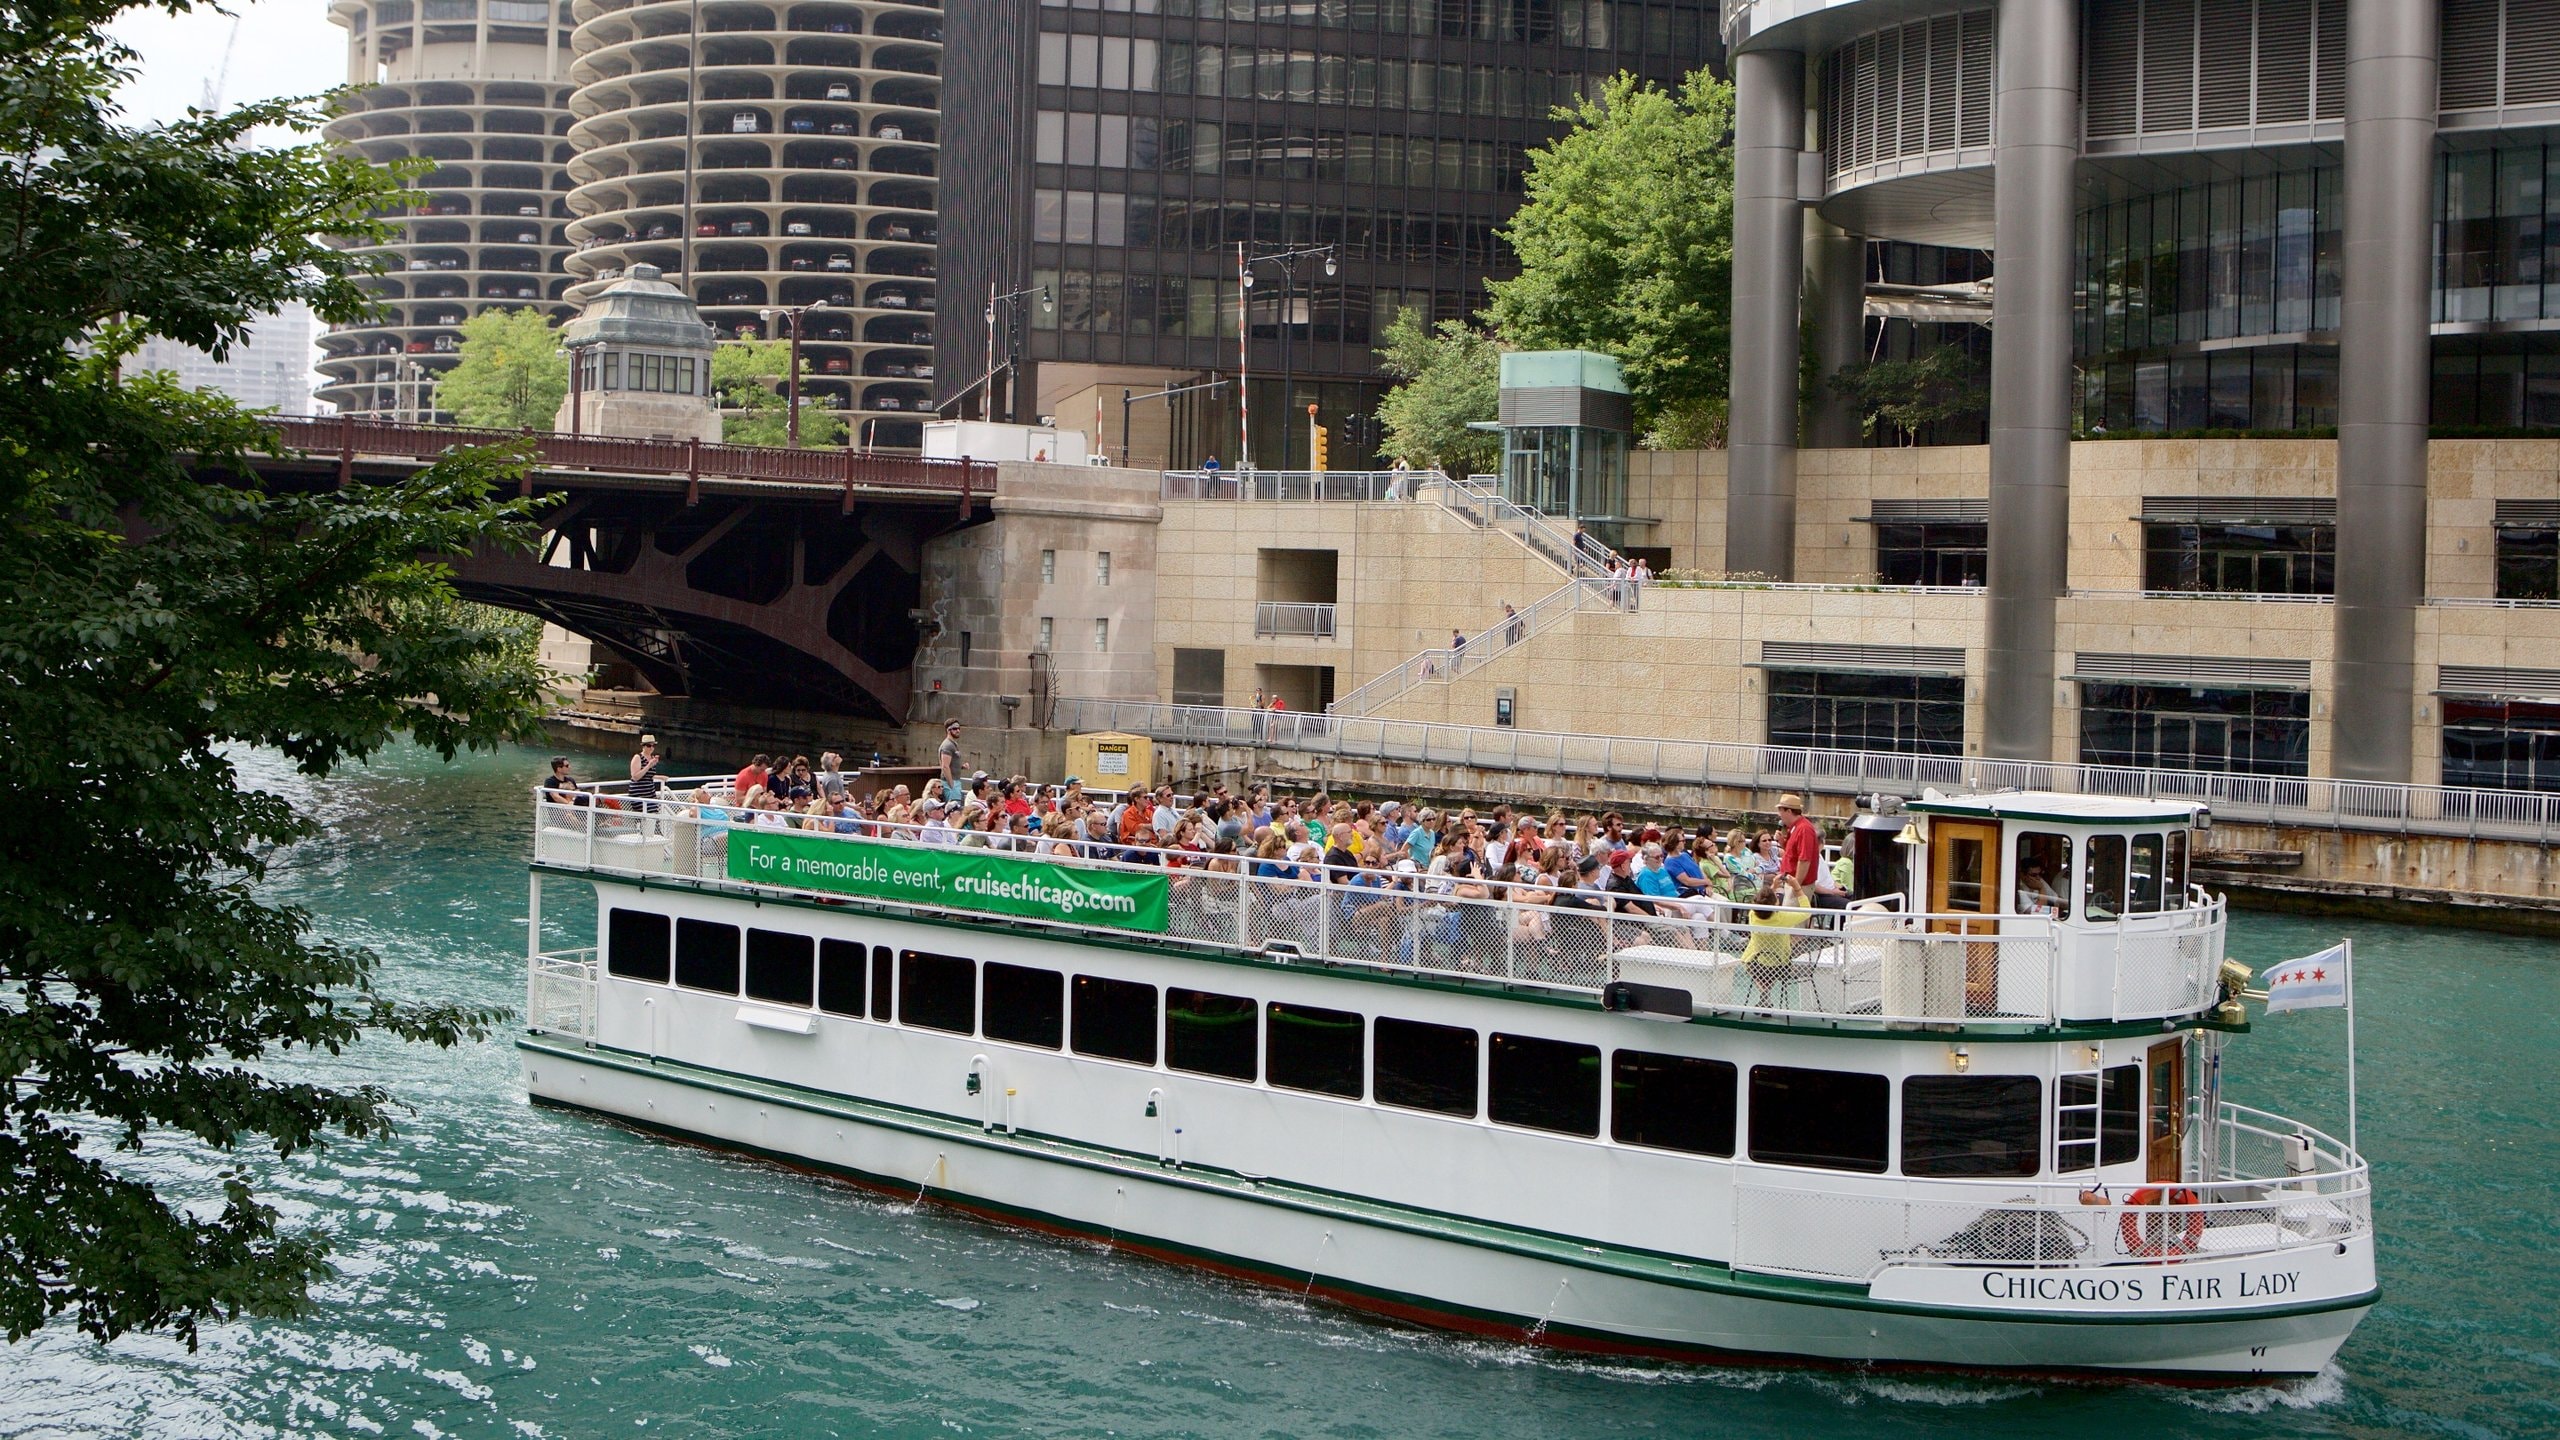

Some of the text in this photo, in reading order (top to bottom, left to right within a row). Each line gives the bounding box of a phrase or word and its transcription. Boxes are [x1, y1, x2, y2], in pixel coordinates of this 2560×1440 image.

[749, 845, 1136, 914] For a memorable event, cruisechicago.com
[1982, 1271, 2301, 1301] CHICAGO'S FAIR LADY
